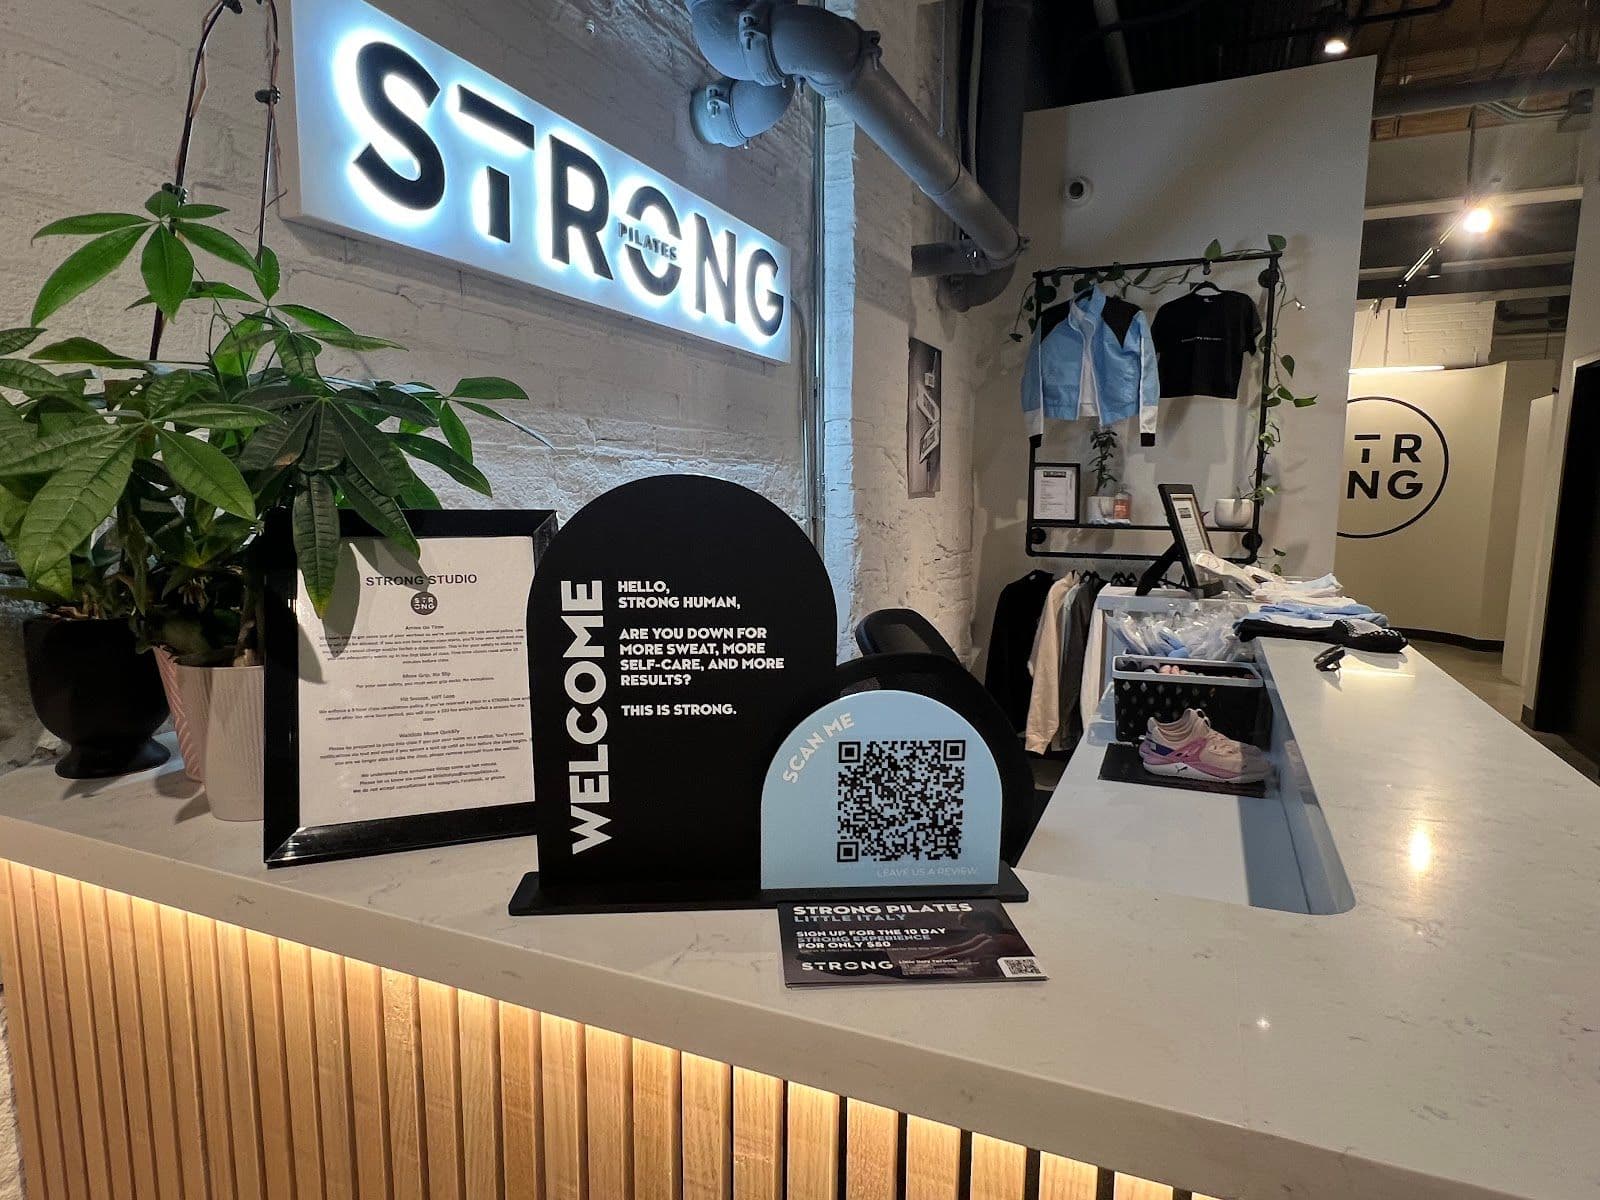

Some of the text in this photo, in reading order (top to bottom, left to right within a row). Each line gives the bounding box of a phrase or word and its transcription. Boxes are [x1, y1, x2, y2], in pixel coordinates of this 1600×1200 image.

[353, 41, 784, 337] STRONG
[618, 222, 677, 261] PILATES
[366, 574, 477, 586] STRONG STUDIO
[617, 580, 671, 595] HELLO,
[618, 596, 741, 609] STRONG HUMAN,
[619, 627, 767, 640] ARE YOU DOWN FOR
[619, 642, 766, 657] MORE SWEAT, MORE
[620, 657, 785, 672] SELF-CARE, AND MORE
[620, 674, 692, 686] RESULTS?
[621, 703, 737, 716] THIS IS STRONG.
[560, 580, 613, 855] WELCOME
[782, 712, 855, 784] SCAN ME
[937, 866, 977, 876] REVIEW
[792, 903, 973, 915] STRONG PILATES
[793, 915, 852, 923] LITTLE
[852, 934, 931, 942] EXPERIENCE
[801, 961, 894, 971] STRONG
